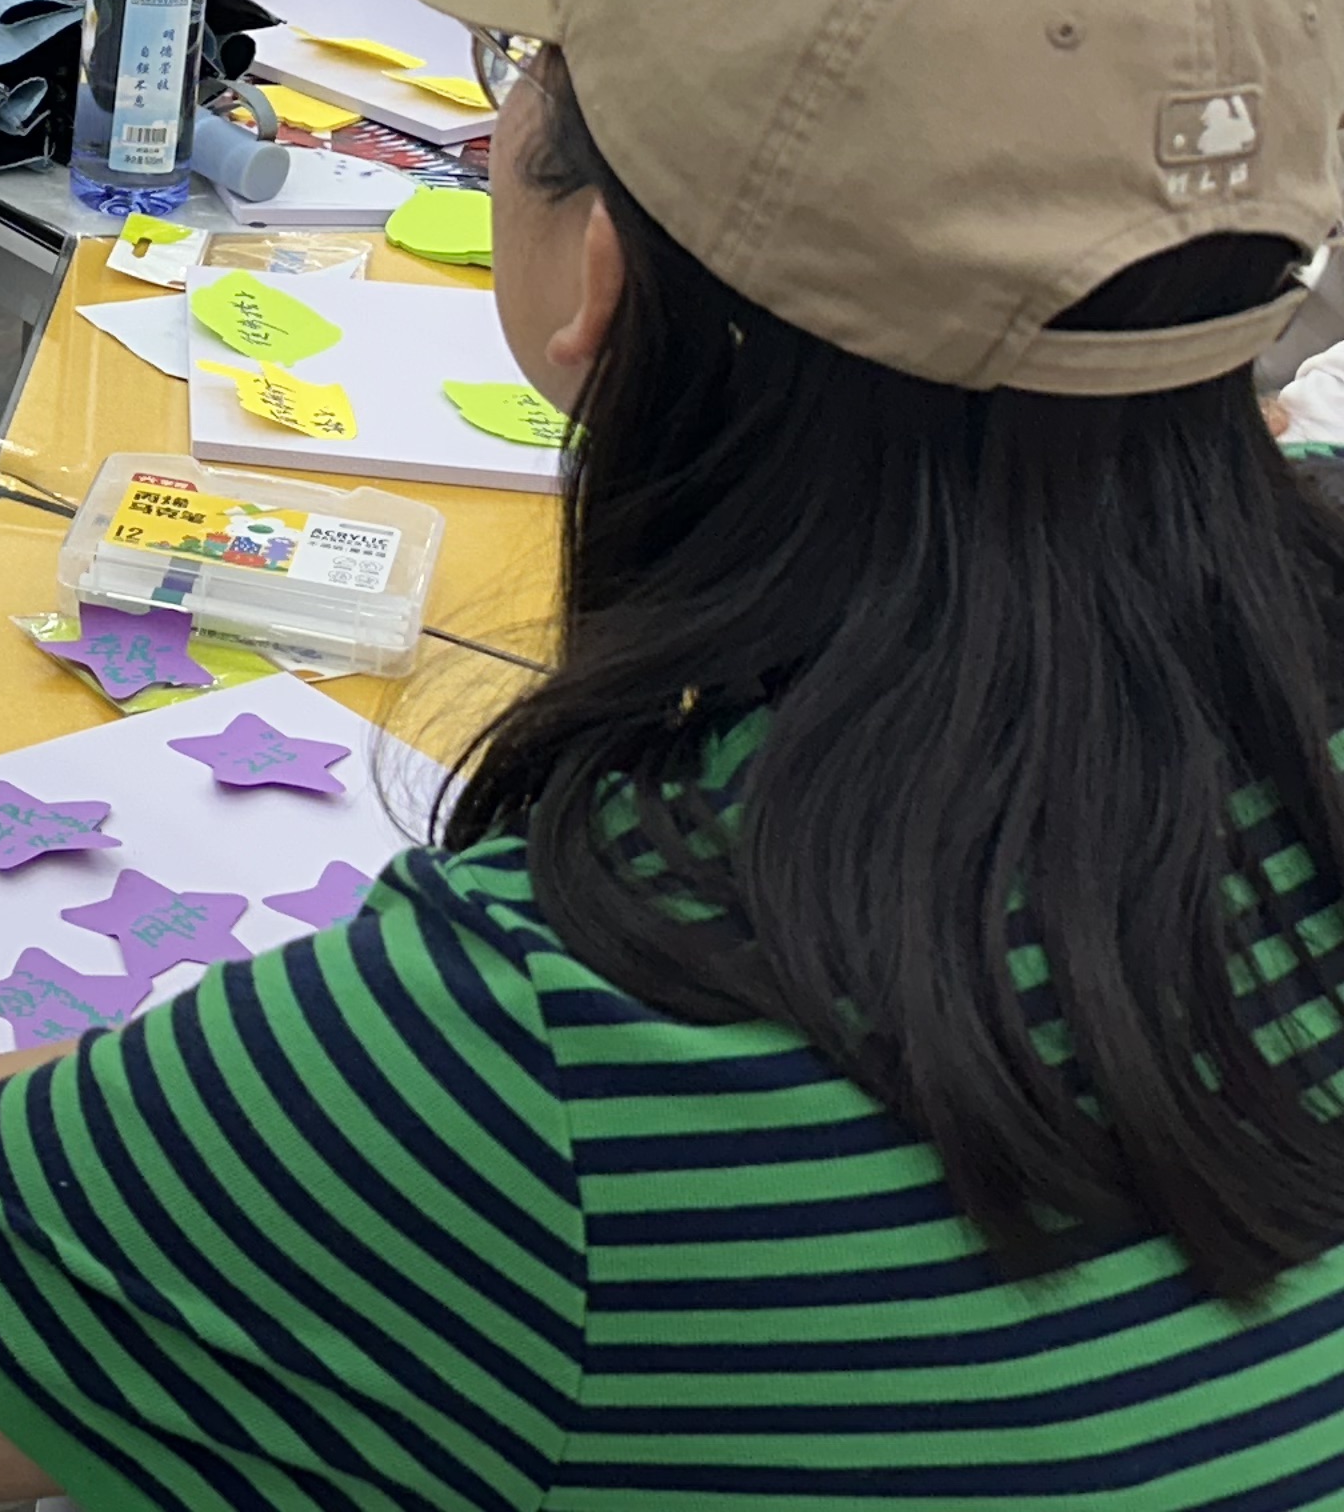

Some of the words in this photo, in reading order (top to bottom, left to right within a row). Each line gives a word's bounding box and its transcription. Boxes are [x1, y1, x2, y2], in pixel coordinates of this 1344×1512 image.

[1167, 162, 1249, 195] MLB
[129, 501, 207, 525] 马克笔
[113, 524, 145, 541] 12
